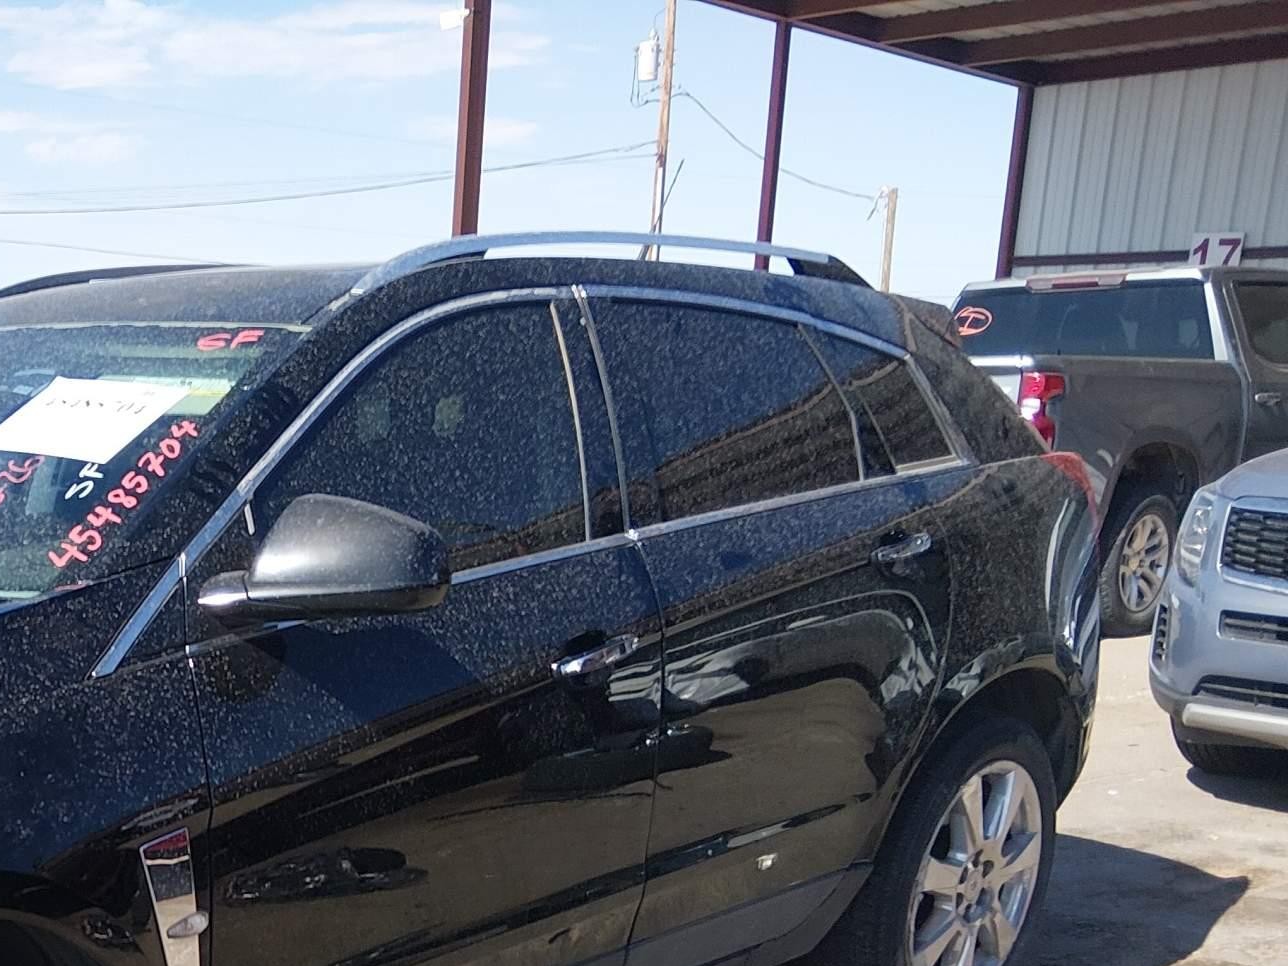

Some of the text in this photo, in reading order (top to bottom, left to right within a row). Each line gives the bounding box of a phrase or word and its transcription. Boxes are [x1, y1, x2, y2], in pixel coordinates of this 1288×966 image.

[1193, 238, 1241, 265] 17
[196, 328, 265, 351] SF
[48, 420, 199, 567] 45485704
